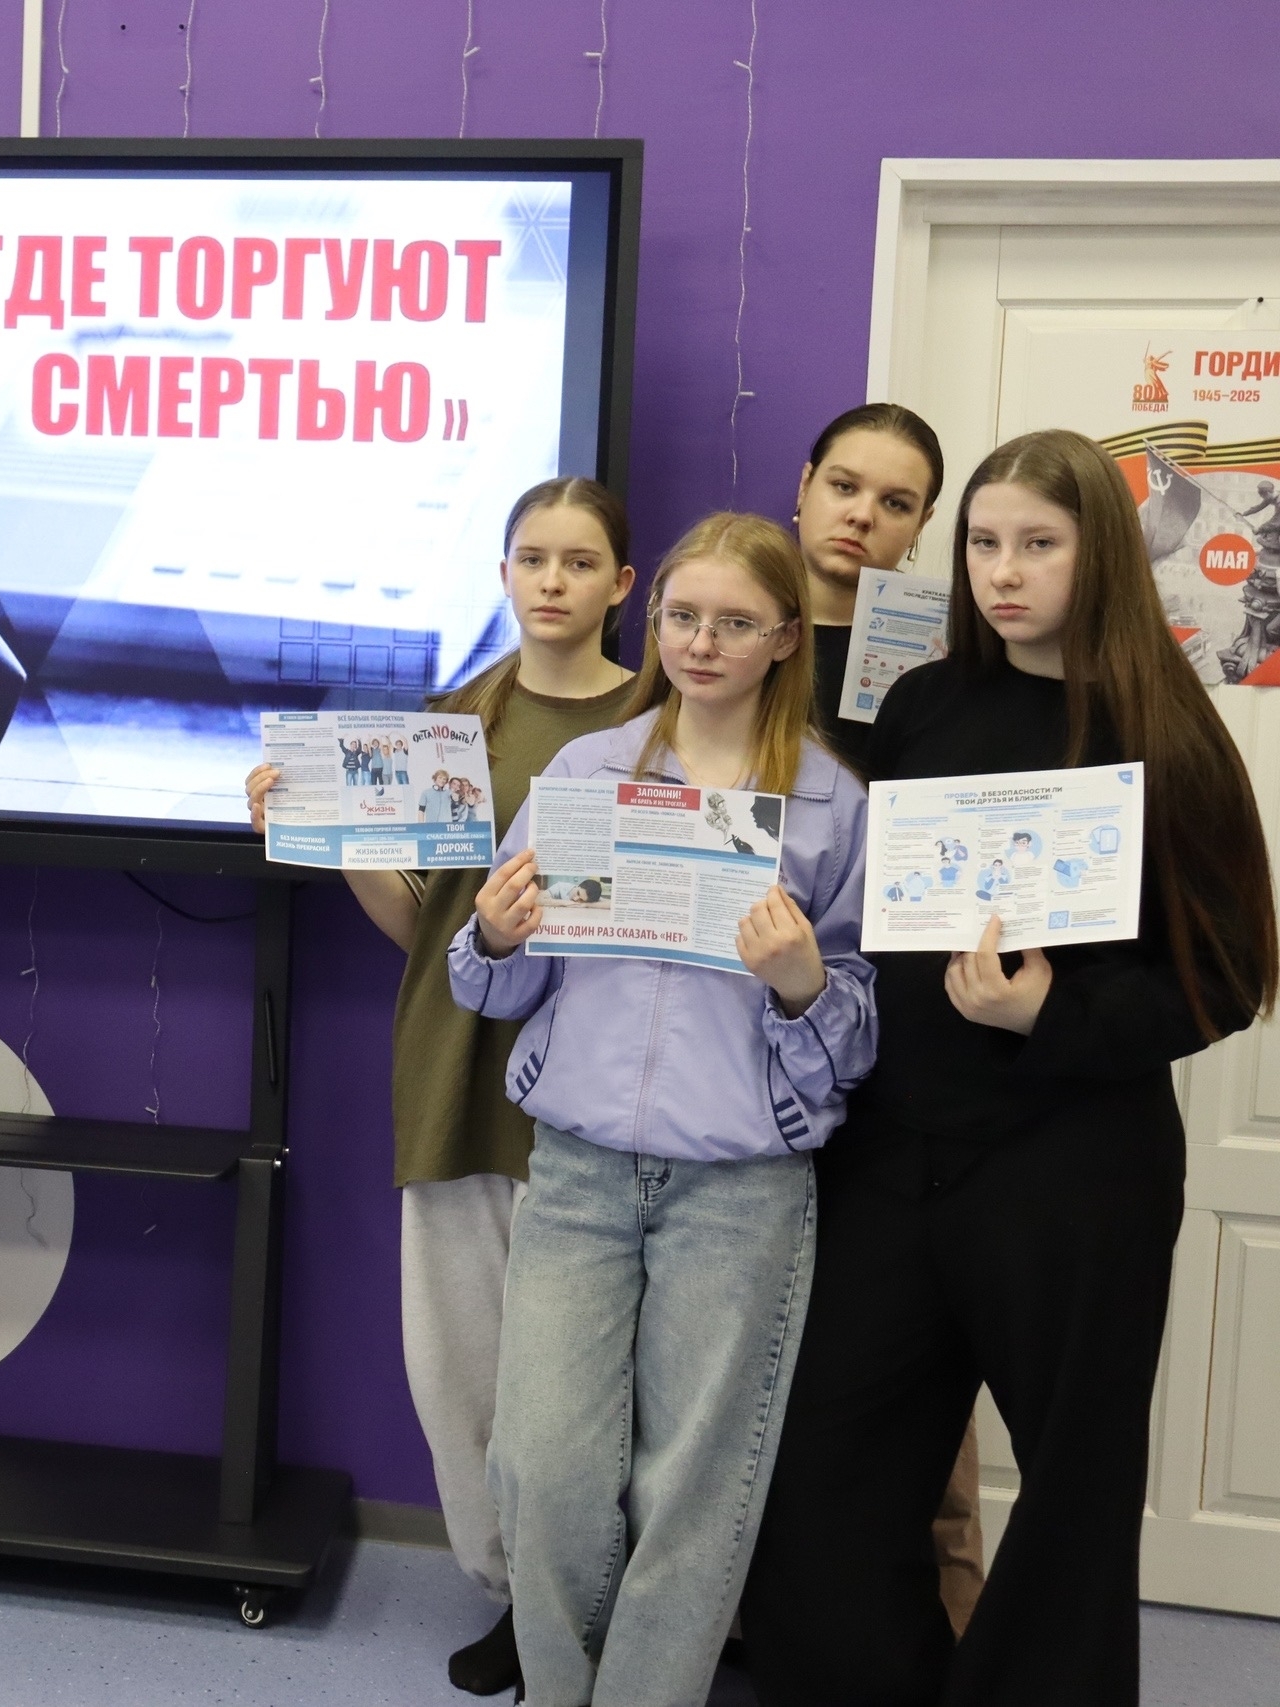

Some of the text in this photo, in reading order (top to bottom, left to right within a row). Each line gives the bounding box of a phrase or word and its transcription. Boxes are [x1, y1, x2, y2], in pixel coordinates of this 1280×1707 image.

[130, 236, 501, 322] ТОРГУЮТ
[1133, 384, 1154, 400] 80
[1132, 403, 1169, 412] ПОБЕДА!
[1206, 550, 1249, 570] МАЯ
[636, 787, 682, 800] ЗАПОМНИ!
[987, 787, 1051, 797] БЕЗОПАСНОСТИ
[976, 797, 1007, 806] ДРУЗЬЯ
[1014, 794, 1053, 802] БЛИЗКИЕ!
[446, 823, 465, 832] ТВОИ
[276, 841, 296, 849] ЖИЗНЬ
[290, 835, 326, 844] НАРКОТИКОВ
[355, 847, 403, 855] ЖИЗНЬ БОГАЧЕ
[435, 843, 474, 855] ДОРОЖЕ
[567, 925, 597, 938] ОДИН
[597, 926, 614, 937] РАЗ
[616, 927, 658, 940] СКАЗАТЬ
[660, 931, 688, 943] «НЕТ»
